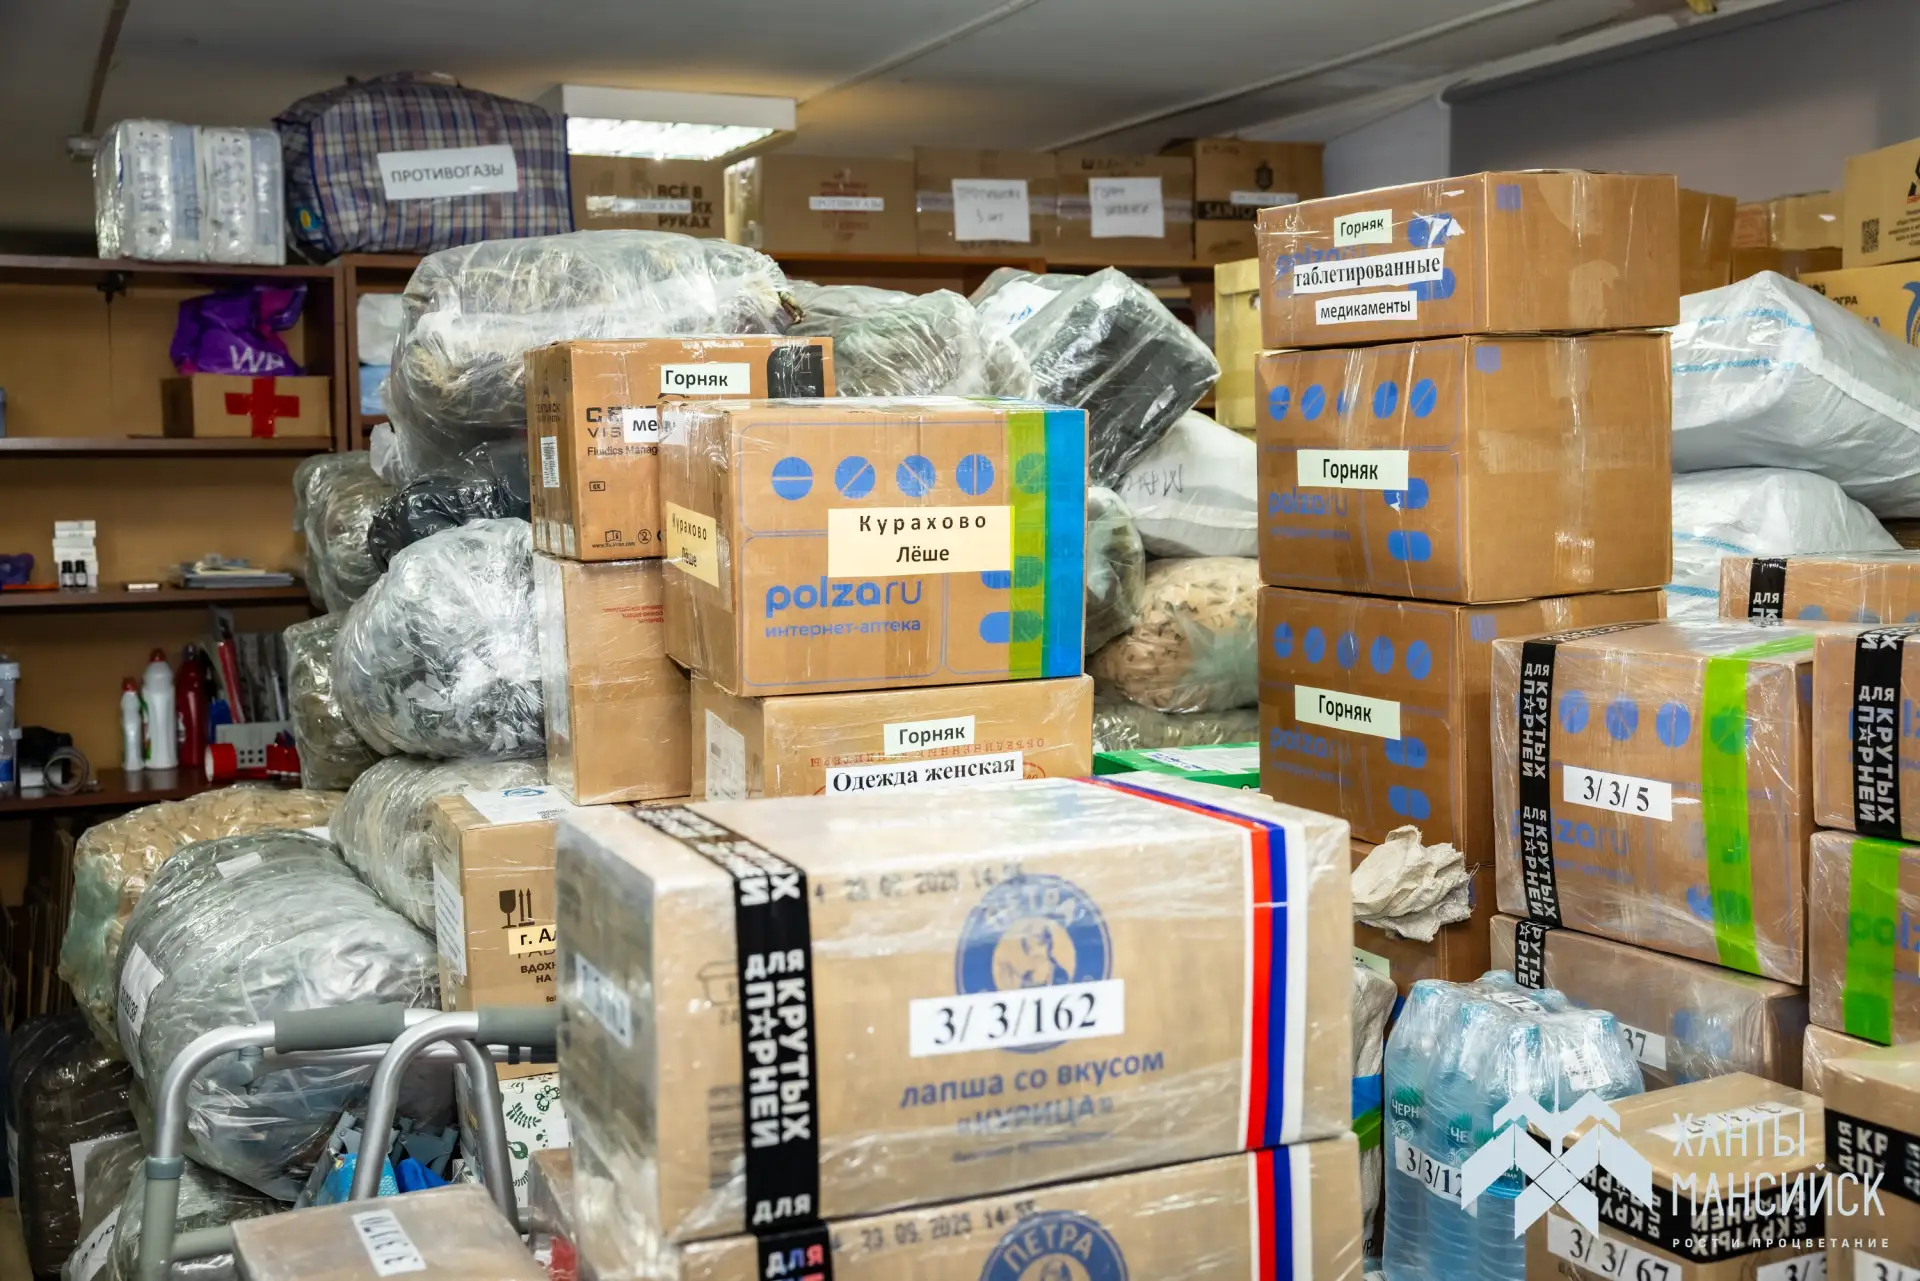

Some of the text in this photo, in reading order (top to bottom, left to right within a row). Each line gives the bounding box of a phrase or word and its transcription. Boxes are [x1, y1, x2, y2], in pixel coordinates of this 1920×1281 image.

[391, 163, 504, 183] ПРОТИВОГАЗЫ
[657, 215, 712, 229] РУКАХ
[1340, 217, 1384, 238] Горняк
[1294, 256, 1440, 287] таблетированные
[1320, 299, 1411, 320] медикаменты
[665, 370, 728, 388] Горняк
[1322, 458, 1379, 484] Горняк
[671, 513, 707, 541] Курахово
[859, 514, 987, 536] Курахово
[896, 543, 950, 563] Лёше
[1753, 591, 1780, 605] ДЛЯ
[765, 619, 921, 640] интернет-аптека
[1524, 663, 1550, 678] ДЛЯ
[1859, 685, 1895, 702] ДЛЯ
[1318, 694, 1372, 723] Горняк
[899, 725, 965, 746] Горняк
[1534, 681, 1549, 780] КРУТЫХ
[833, 758, 1016, 792] Одежда женская
[1876, 707, 1896, 825] КРУТЫХ
[1636, 786, 1650, 812] 5
[1523, 806, 1547, 821] ДЛЯ
[1535, 824, 1557, 919] КРУТЫХ
[520, 934, 533, 946] г.
[744, 949, 805, 981] ДЛЯ
[1530, 925, 1544, 989] РУТЫ
[536, 974, 552, 983] НА
[777, 977, 811, 1144] КРУТЫХ
[900, 1052, 1165, 1108] лапша со вкусом
[1838, 1120, 1855, 1173] ДЛЯ
[752, 1193, 811, 1226] ДЛЯ
[1003, 1223, 1093, 1273] ПЕТРА
[765, 1244, 824, 1279] ДЛЯ
